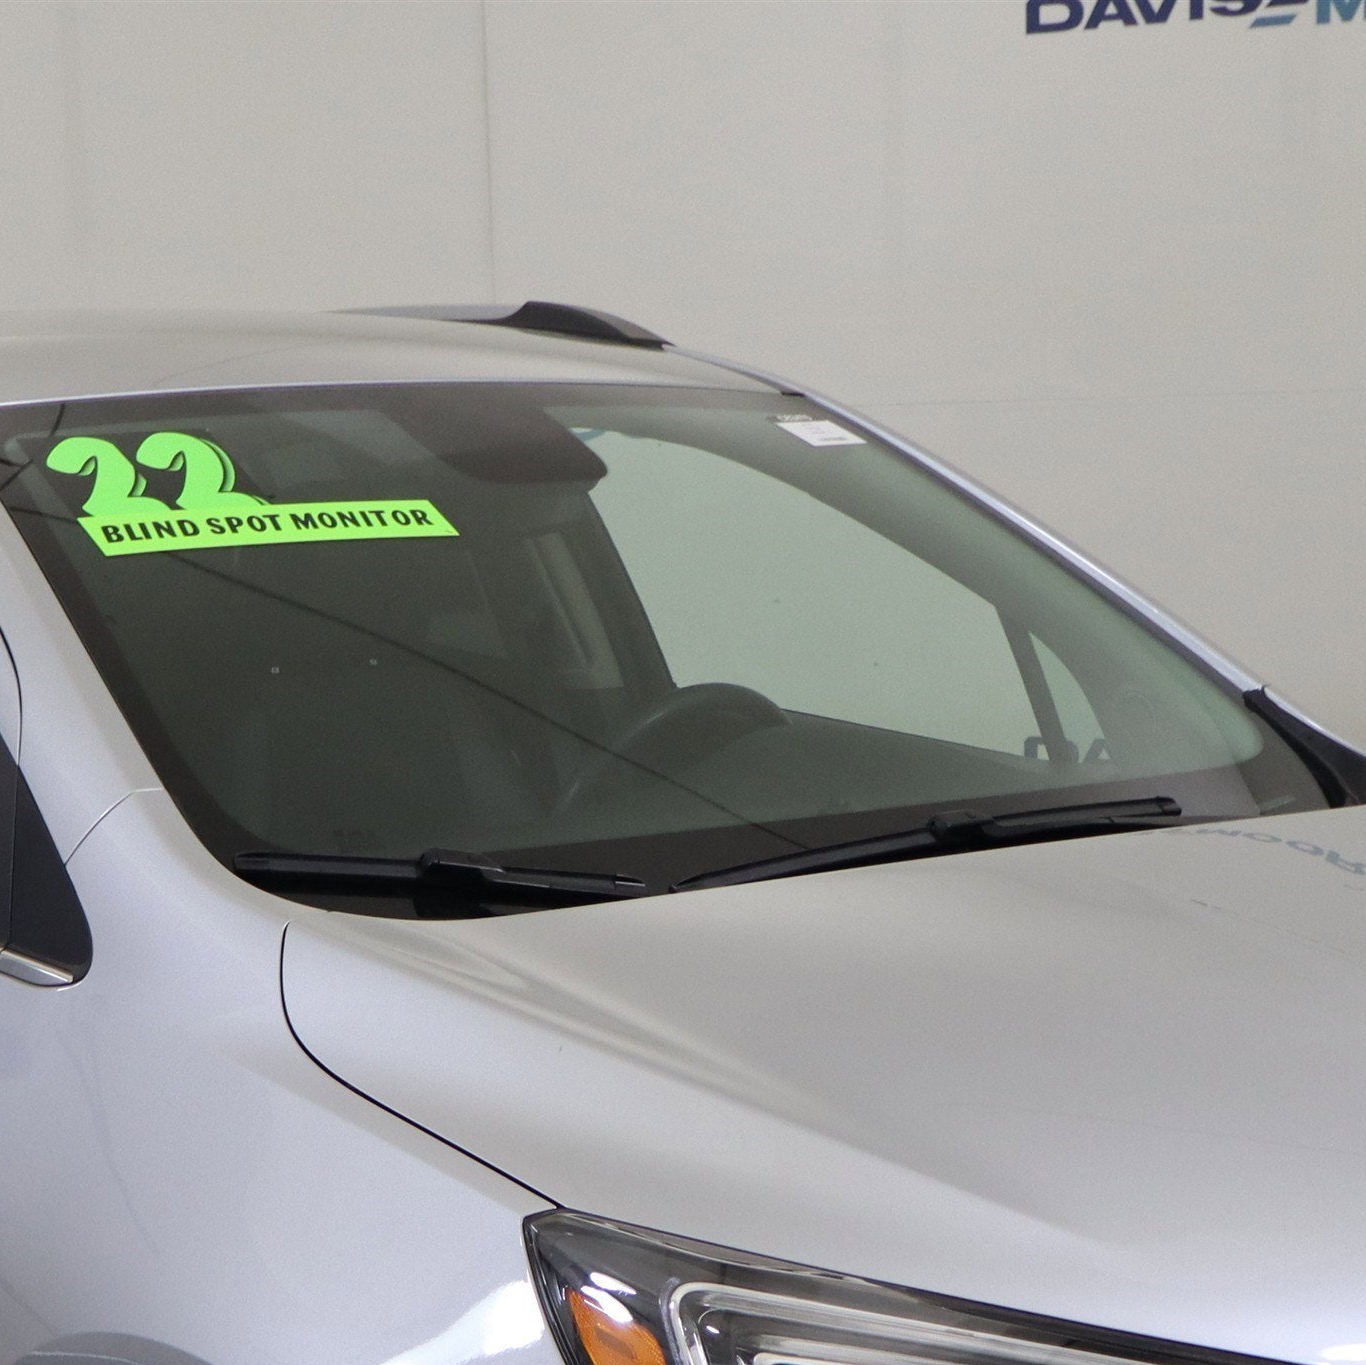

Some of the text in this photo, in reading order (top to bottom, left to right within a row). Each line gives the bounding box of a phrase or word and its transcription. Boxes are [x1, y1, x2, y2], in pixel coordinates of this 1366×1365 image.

[45, 431, 269, 517] 22
[100, 508, 434, 544] BLIND SPOT MONITOR
